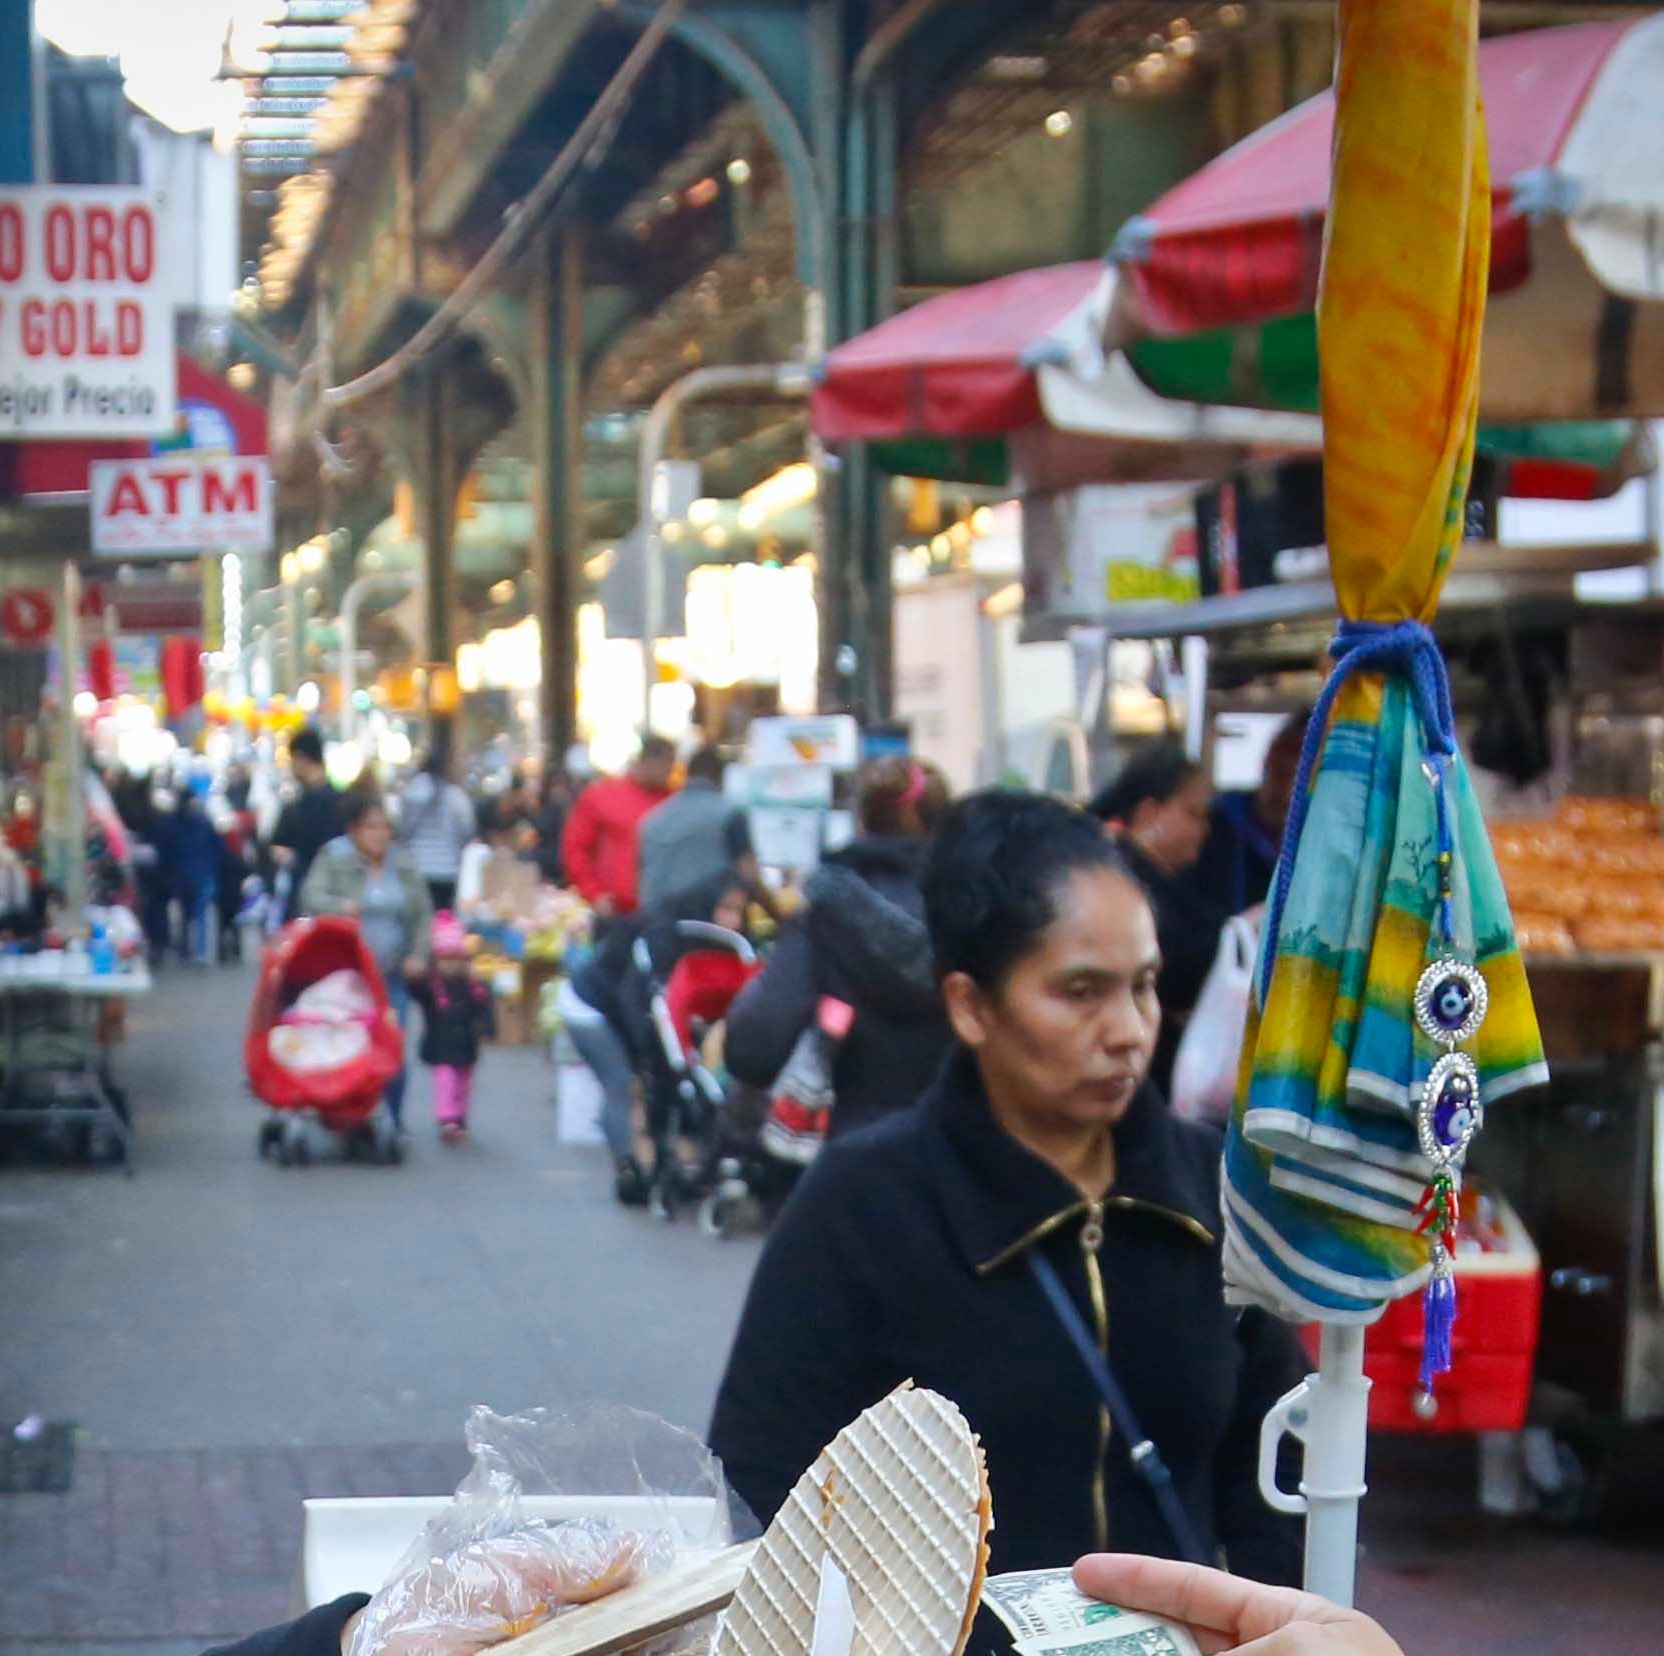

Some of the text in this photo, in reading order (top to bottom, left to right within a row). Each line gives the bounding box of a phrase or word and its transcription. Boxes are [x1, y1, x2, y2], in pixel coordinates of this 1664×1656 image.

[45, 203, 155, 283] ORO
[20, 298, 143, 357] GOLD
[63, 374, 155, 417] Precio
[104, 472, 257, 517] ATM
